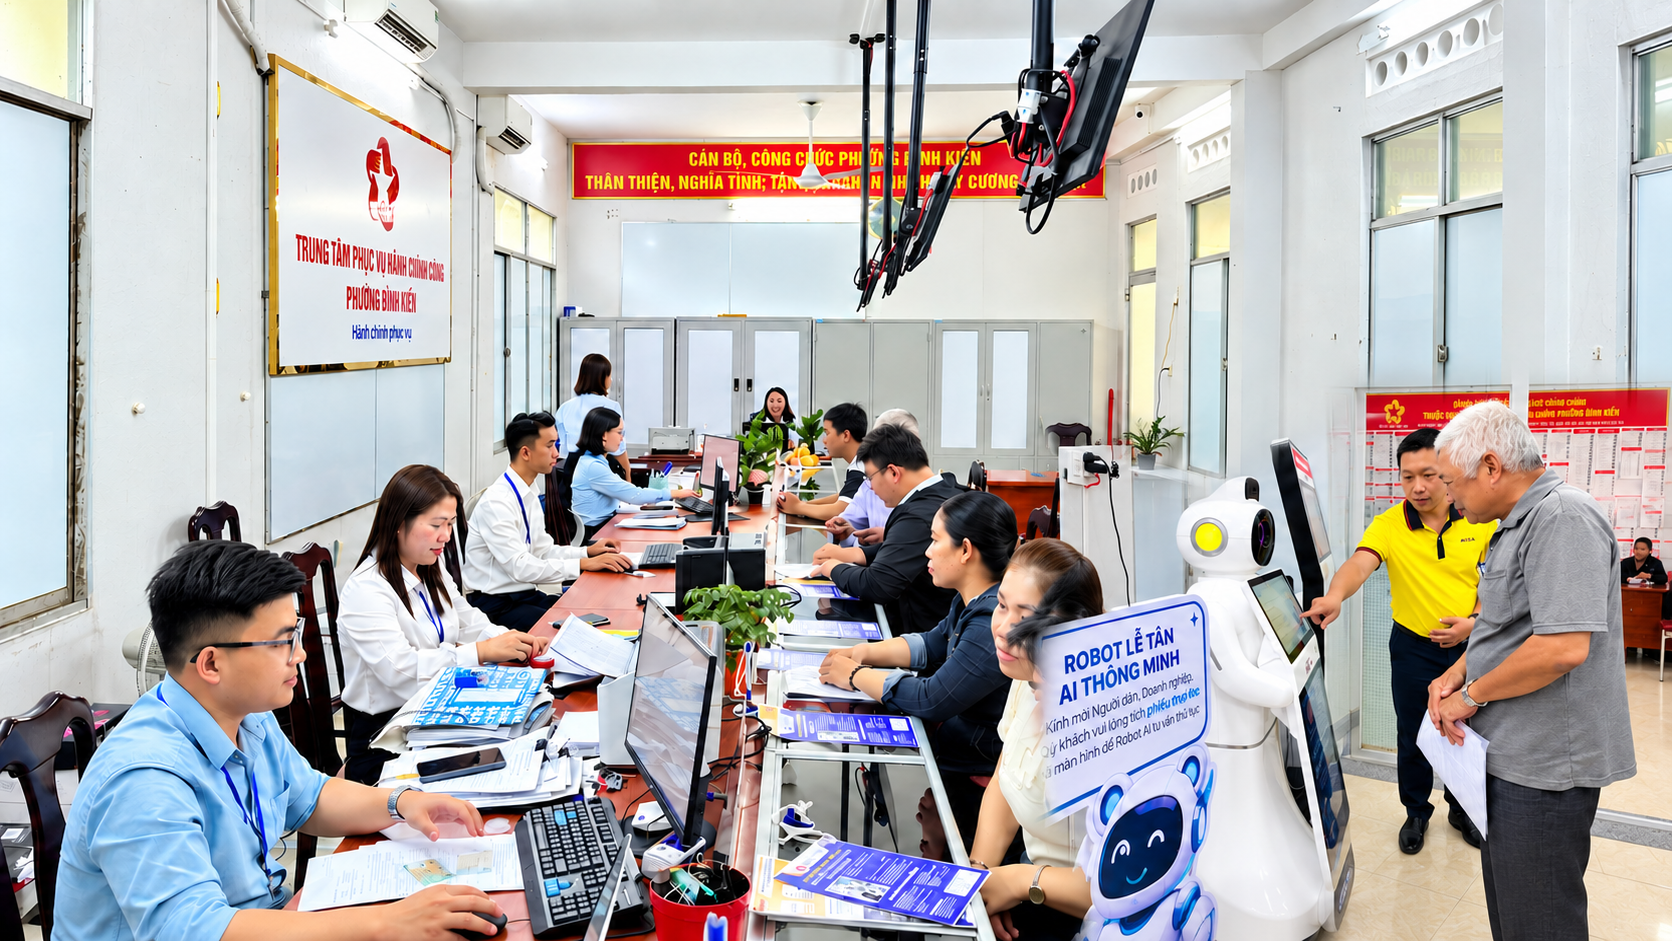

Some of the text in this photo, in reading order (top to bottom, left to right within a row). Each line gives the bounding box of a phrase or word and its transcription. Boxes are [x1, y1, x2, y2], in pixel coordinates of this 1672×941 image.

[689, 148, 718, 167] CÁN
[723, 148, 747, 170] BỘ,
[751, 148, 791, 167] CÔNG
[585, 172, 624, 190] THÂN
[628, 172, 675, 194] THIỆN,
[678, 171, 724, 190] NGHĨA
[295, 234, 329, 265] TRUNG
[331, 237, 350, 268] TÂM
[352, 245, 374, 276] PHỤC
[376, 250, 386, 278] VỤ
[381, 285, 400, 312] BÌNH
[389, 324, 403, 343] phục
[404, 328, 412, 343] vụ
[1064, 625, 1174, 675] ROBOT LỄ TÂN
[1059, 681, 1077, 705] AI
[1081, 662, 1140, 697] THÔNG
[1143, 649, 1180, 676] MINH
[1045, 715, 1069, 735] Kính
[1142, 680, 1167, 699] Doanh
[1059, 728, 1091, 752] khách
[1092, 721, 1107, 737] vui
[1115, 728, 1142, 748] Robot
[1143, 723, 1152, 736] AI
